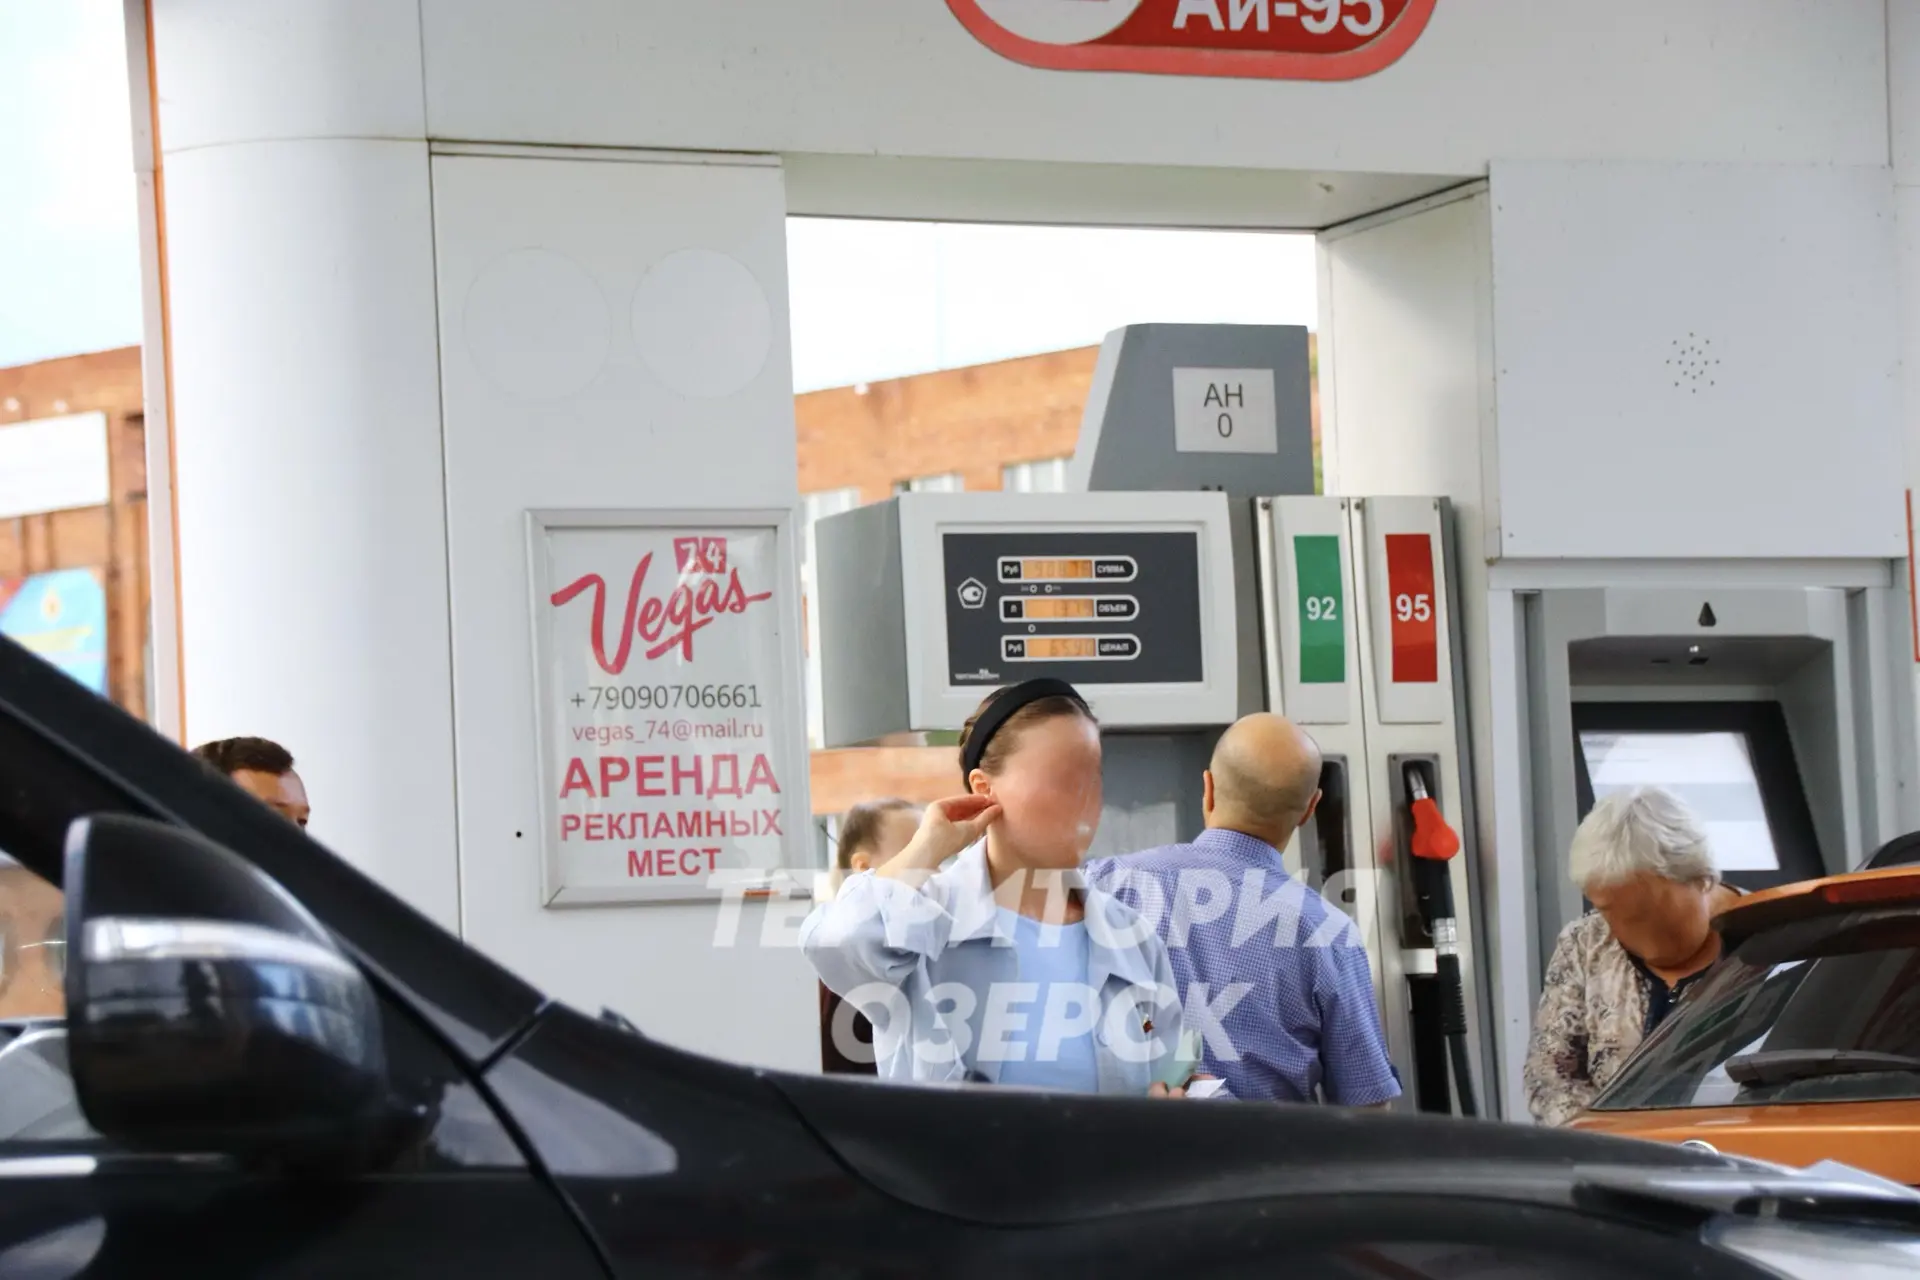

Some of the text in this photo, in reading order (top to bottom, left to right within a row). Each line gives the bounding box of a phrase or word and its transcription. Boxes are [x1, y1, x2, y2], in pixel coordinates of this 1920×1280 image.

[1217, 413, 1233, 438] 0
[680, 541, 724, 571] 74
[550, 551, 772, 675] Vegas
[1306, 596, 1337, 621] 92
[1396, 594, 1431, 622] 95
[570, 684, 762, 710] +79090706661
[572, 718, 763, 746] vegas_74@mail.ru
[559, 753, 781, 800] АРЕНДА
[560, 809, 783, 842] РЕКЛАМНЫХ
[627, 848, 722, 877] МЕСТ
